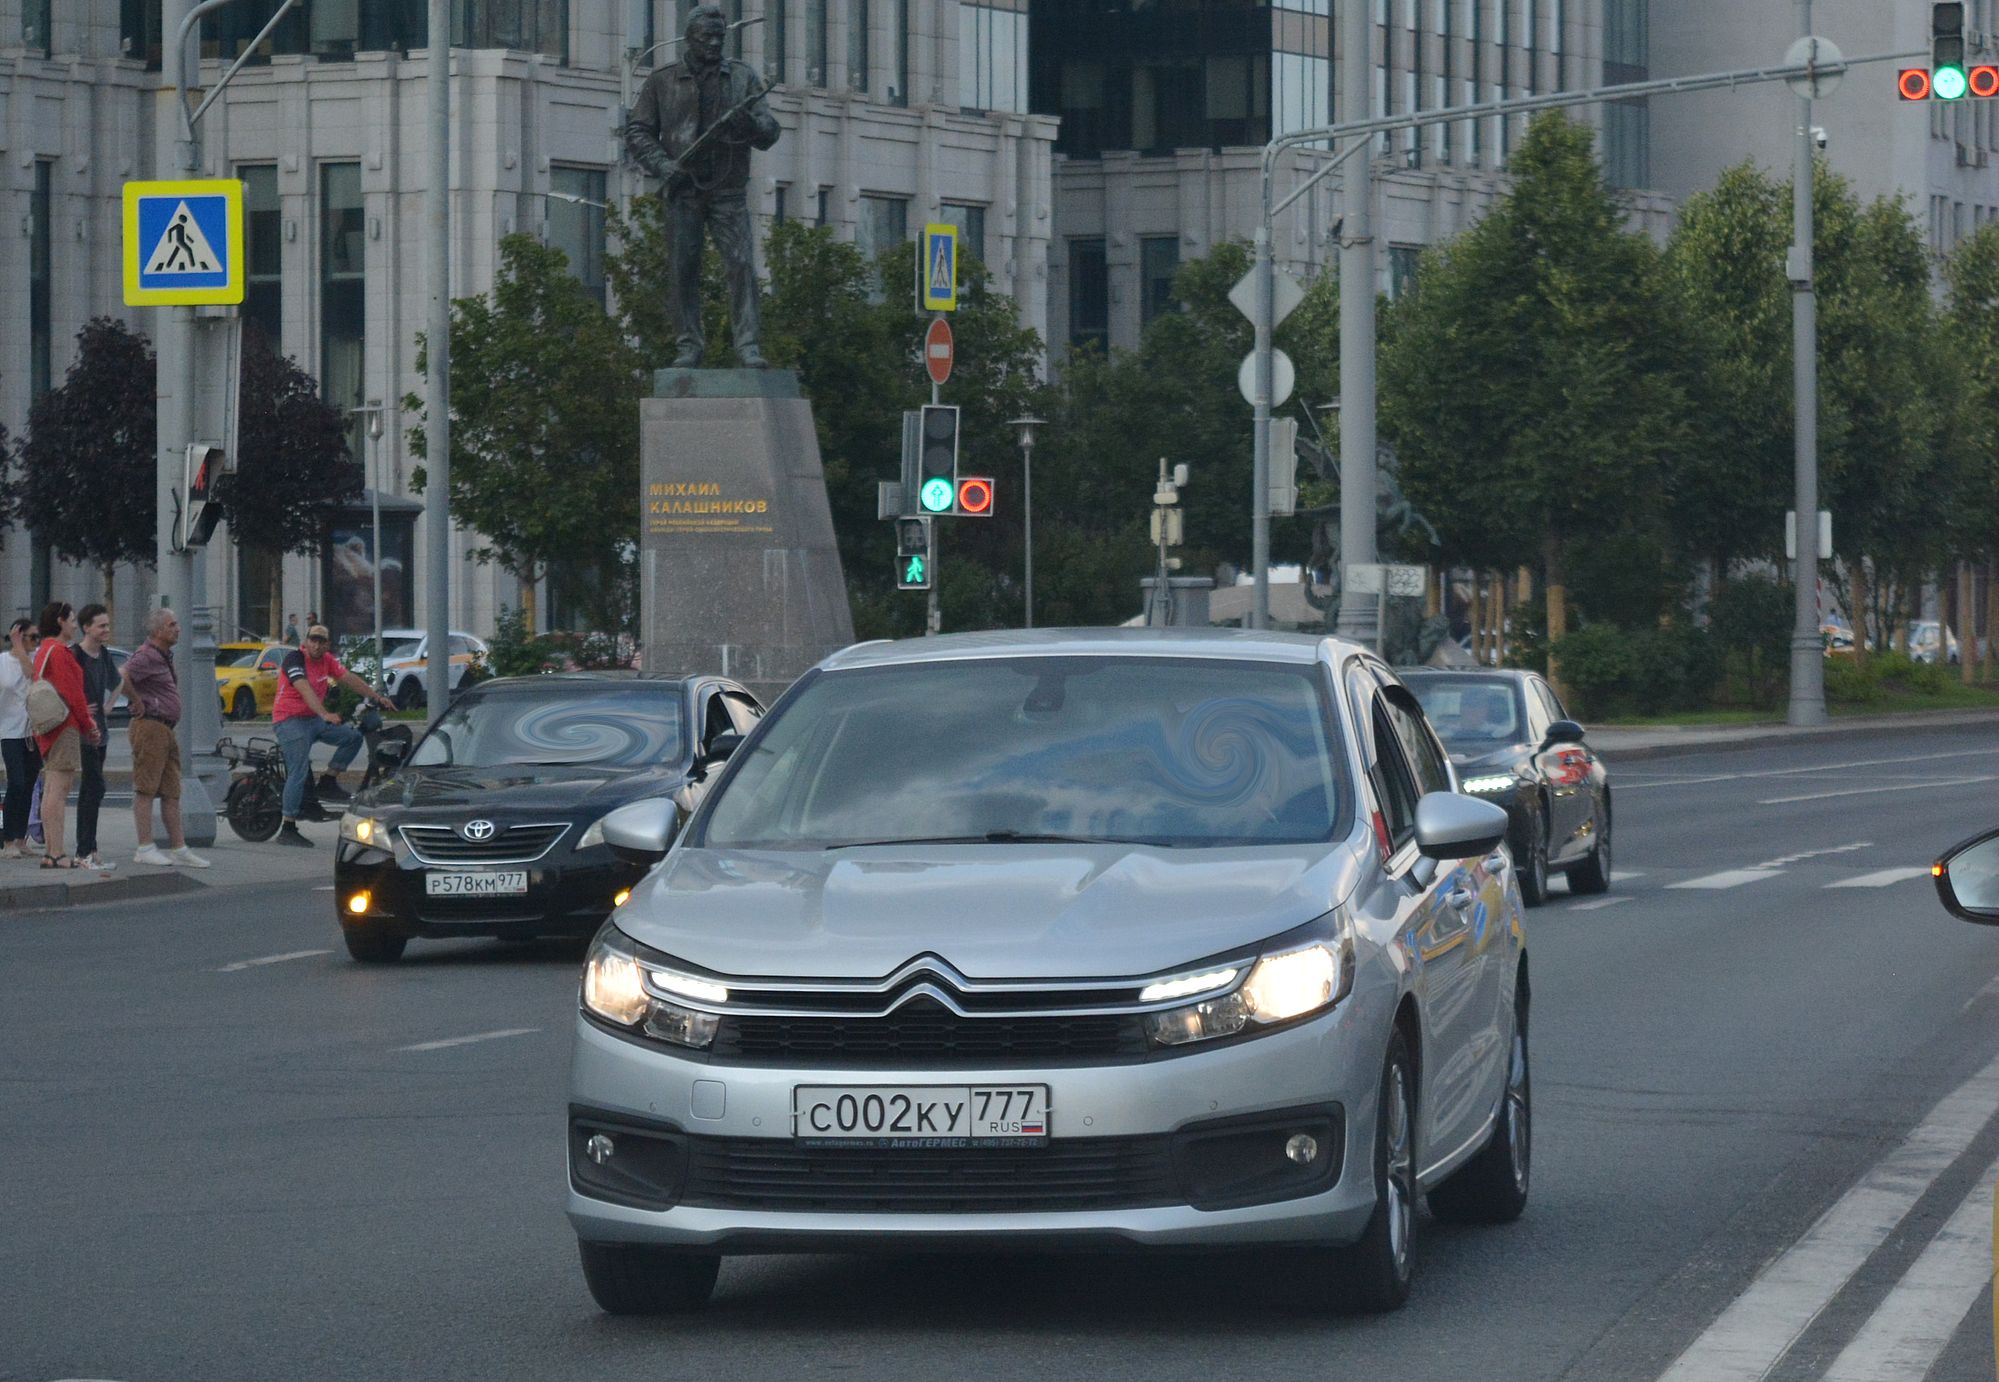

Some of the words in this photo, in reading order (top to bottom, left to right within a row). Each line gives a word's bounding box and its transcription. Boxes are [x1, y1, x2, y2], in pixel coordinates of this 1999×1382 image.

[650, 483, 720, 496] МИХАИЛ
[649, 500, 768, 513] КАЛАШНИКОВ
[498, 873, 522, 887] 977
[974, 1091, 1034, 1121] 777
[990, 1122, 1020, 1133] RUS
